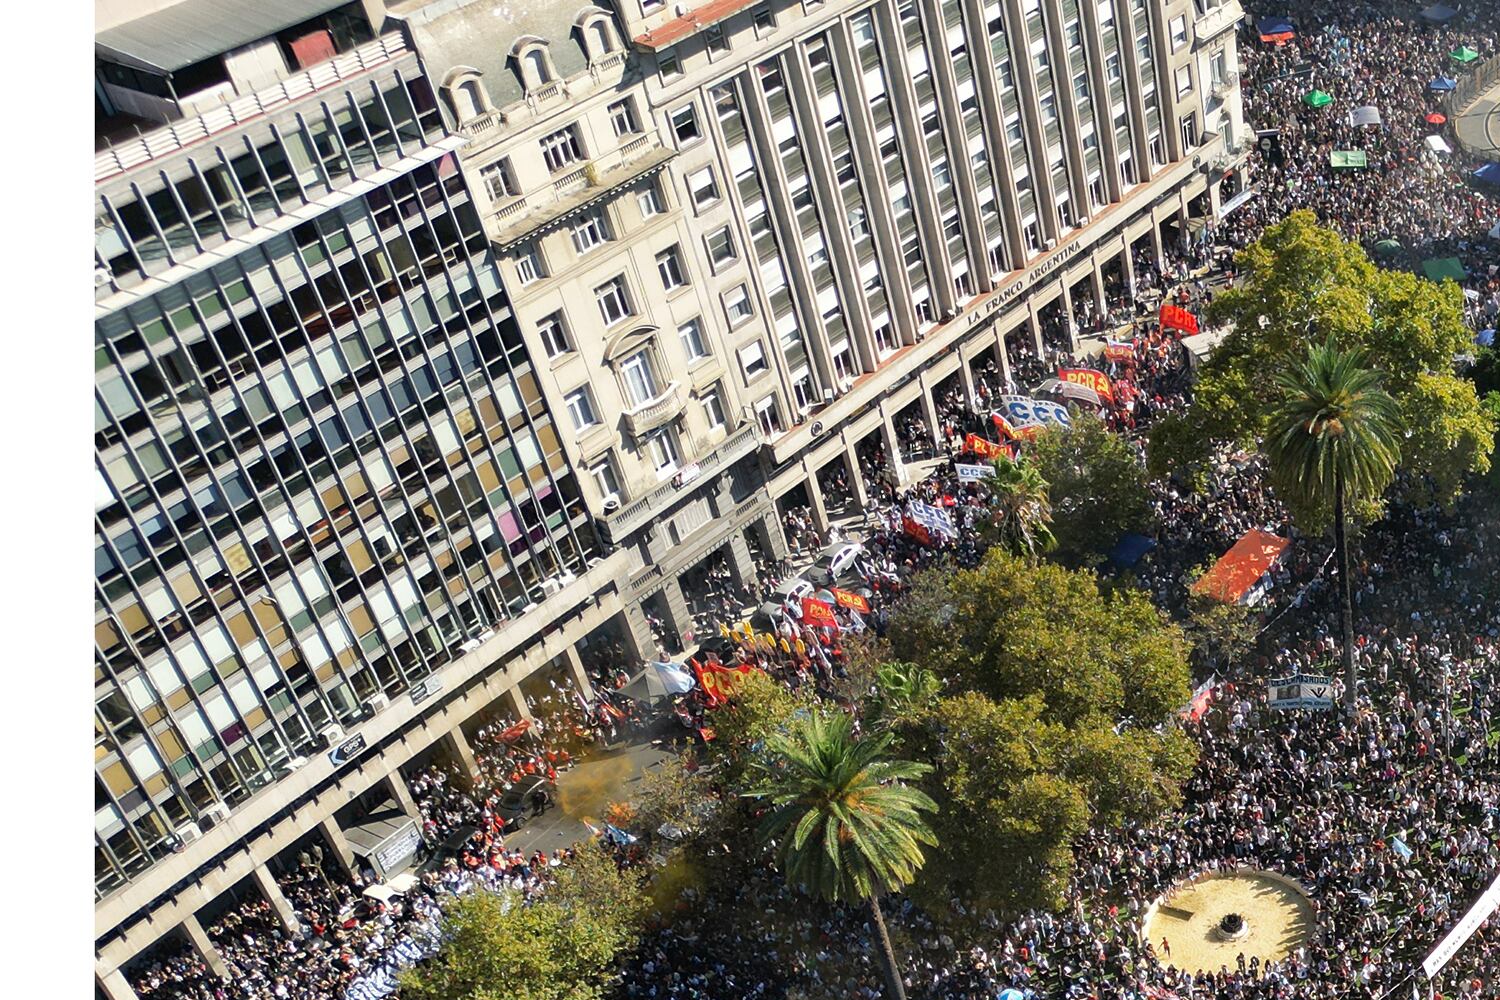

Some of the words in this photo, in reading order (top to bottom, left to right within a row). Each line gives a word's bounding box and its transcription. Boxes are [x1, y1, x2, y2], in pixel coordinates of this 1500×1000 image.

[967, 311, 980, 325] LA
[985, 281, 1023, 313] FRANCO
[1029, 240, 1081, 283] ARGENTINA
[1067, 371, 1096, 391] PCR
[1009, 402, 1071, 429] CCC
